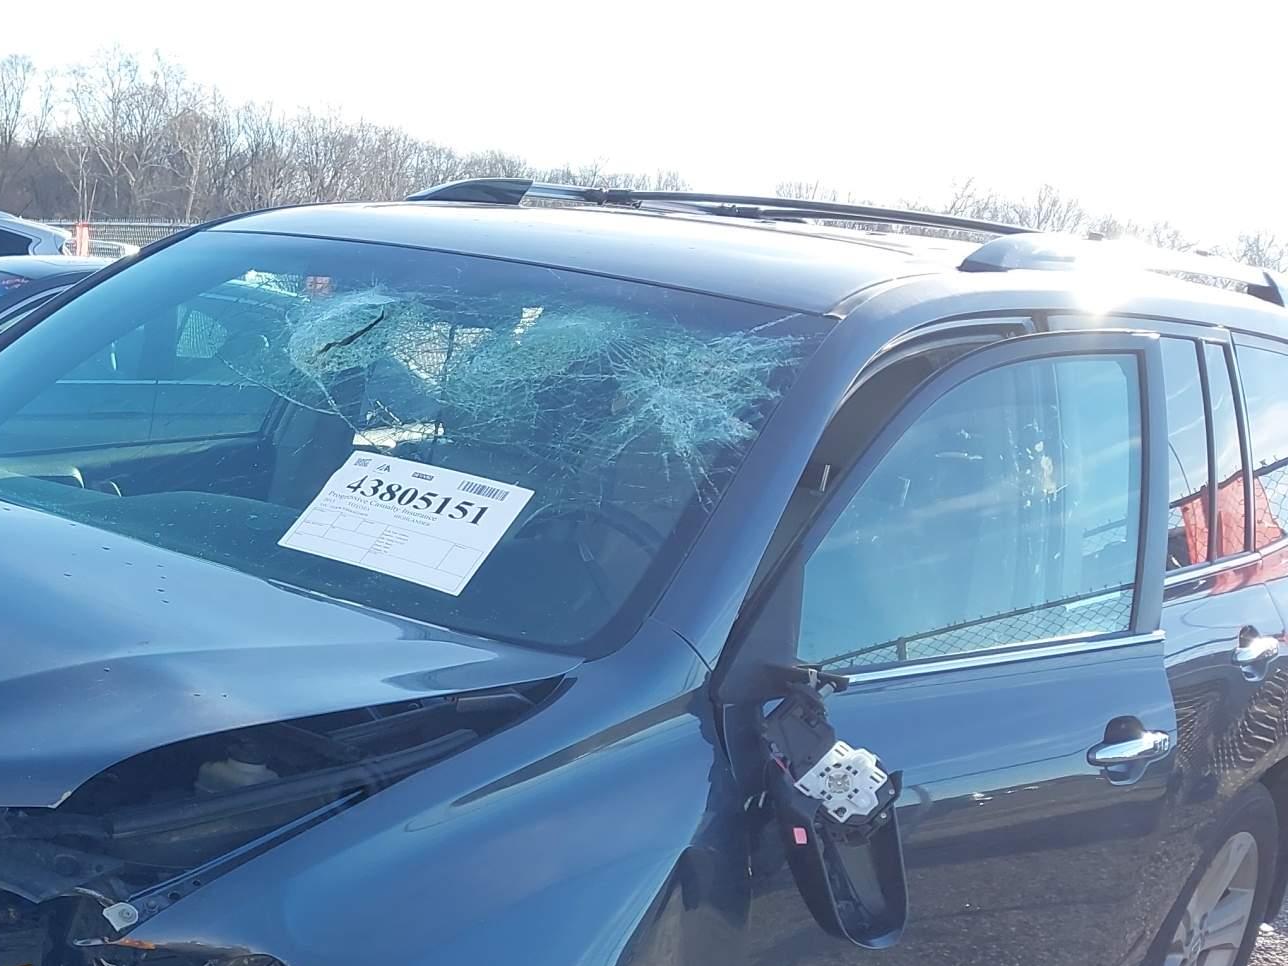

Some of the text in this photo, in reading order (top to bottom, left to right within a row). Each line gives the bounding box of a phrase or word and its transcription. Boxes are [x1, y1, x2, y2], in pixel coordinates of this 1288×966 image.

[346, 474, 489, 526] 43805151
[369, 498, 400, 514] Casualty
[401, 507, 439, 522] Insurance
